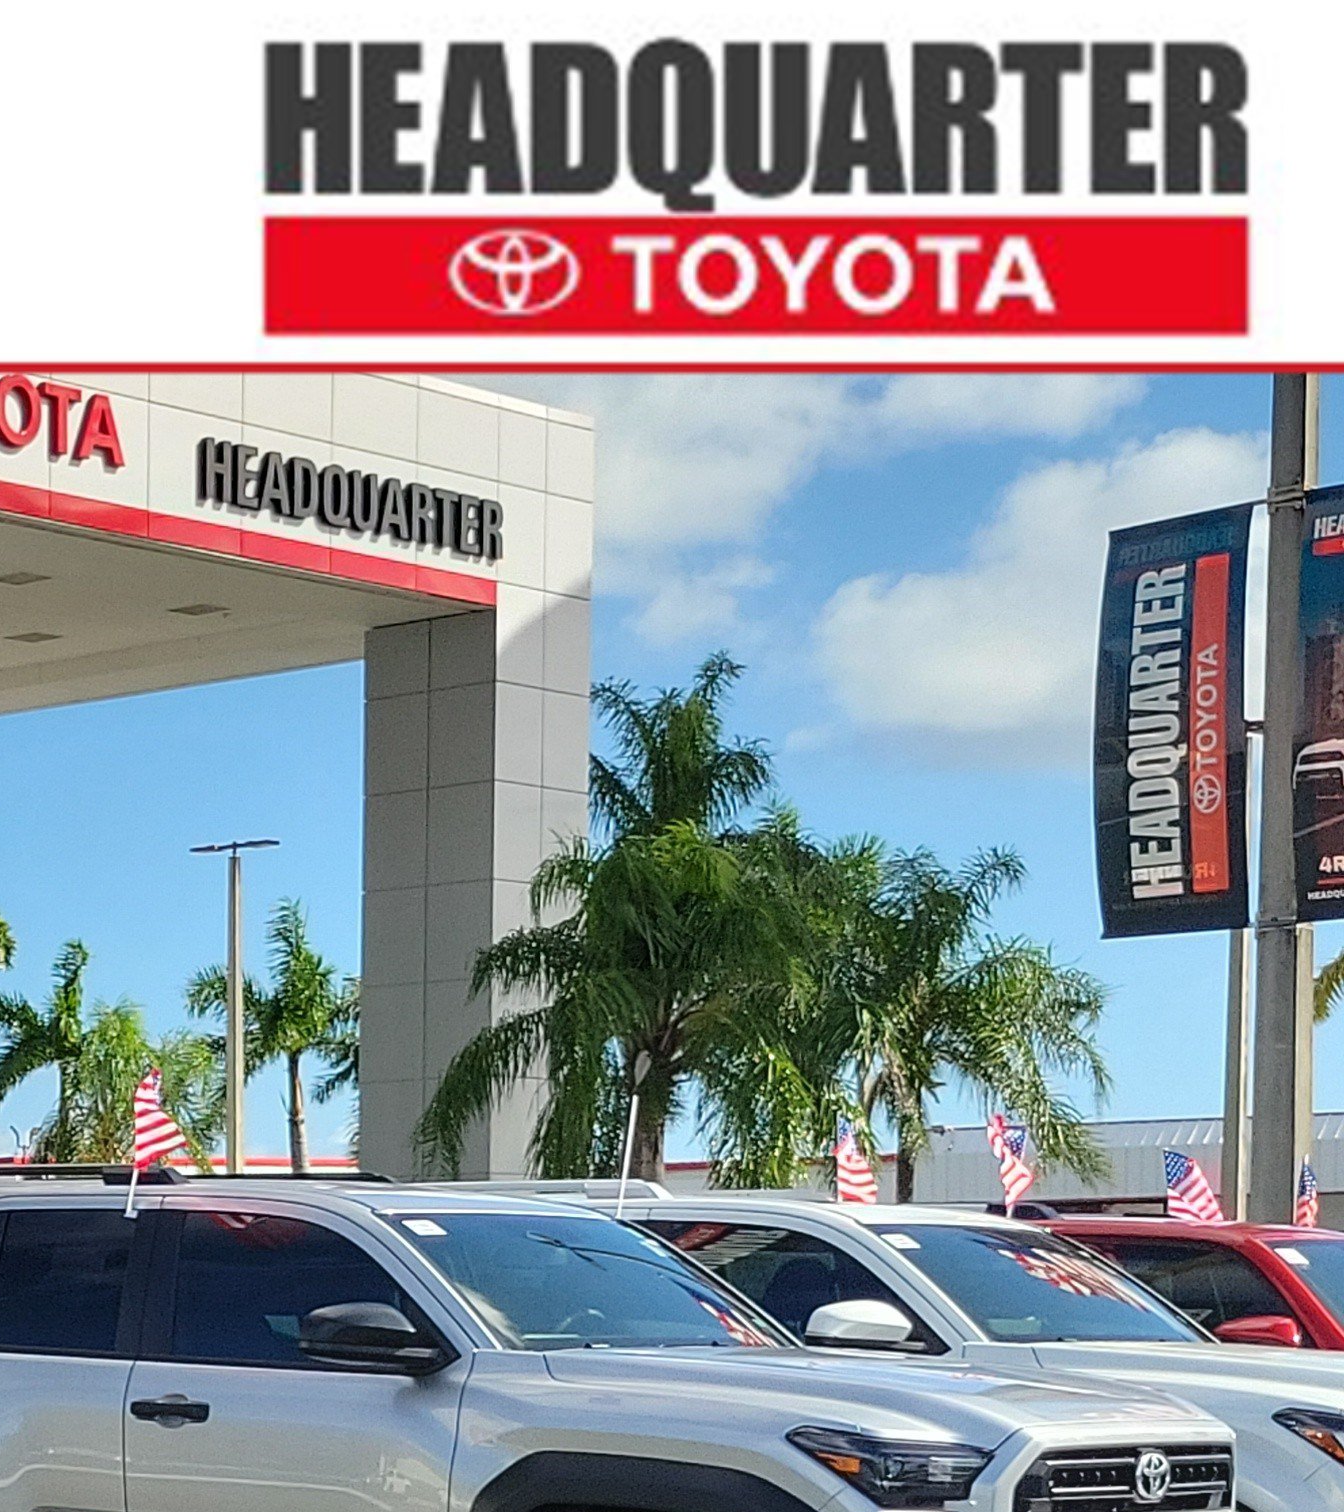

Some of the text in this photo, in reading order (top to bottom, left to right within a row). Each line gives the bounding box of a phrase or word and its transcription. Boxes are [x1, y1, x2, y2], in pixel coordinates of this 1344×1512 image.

[196, 436, 504, 562] HEADQUARTER
[1126, 562, 1188, 900] HEADQUARTER
[1195, 642, 1219, 772] TOYOTA
